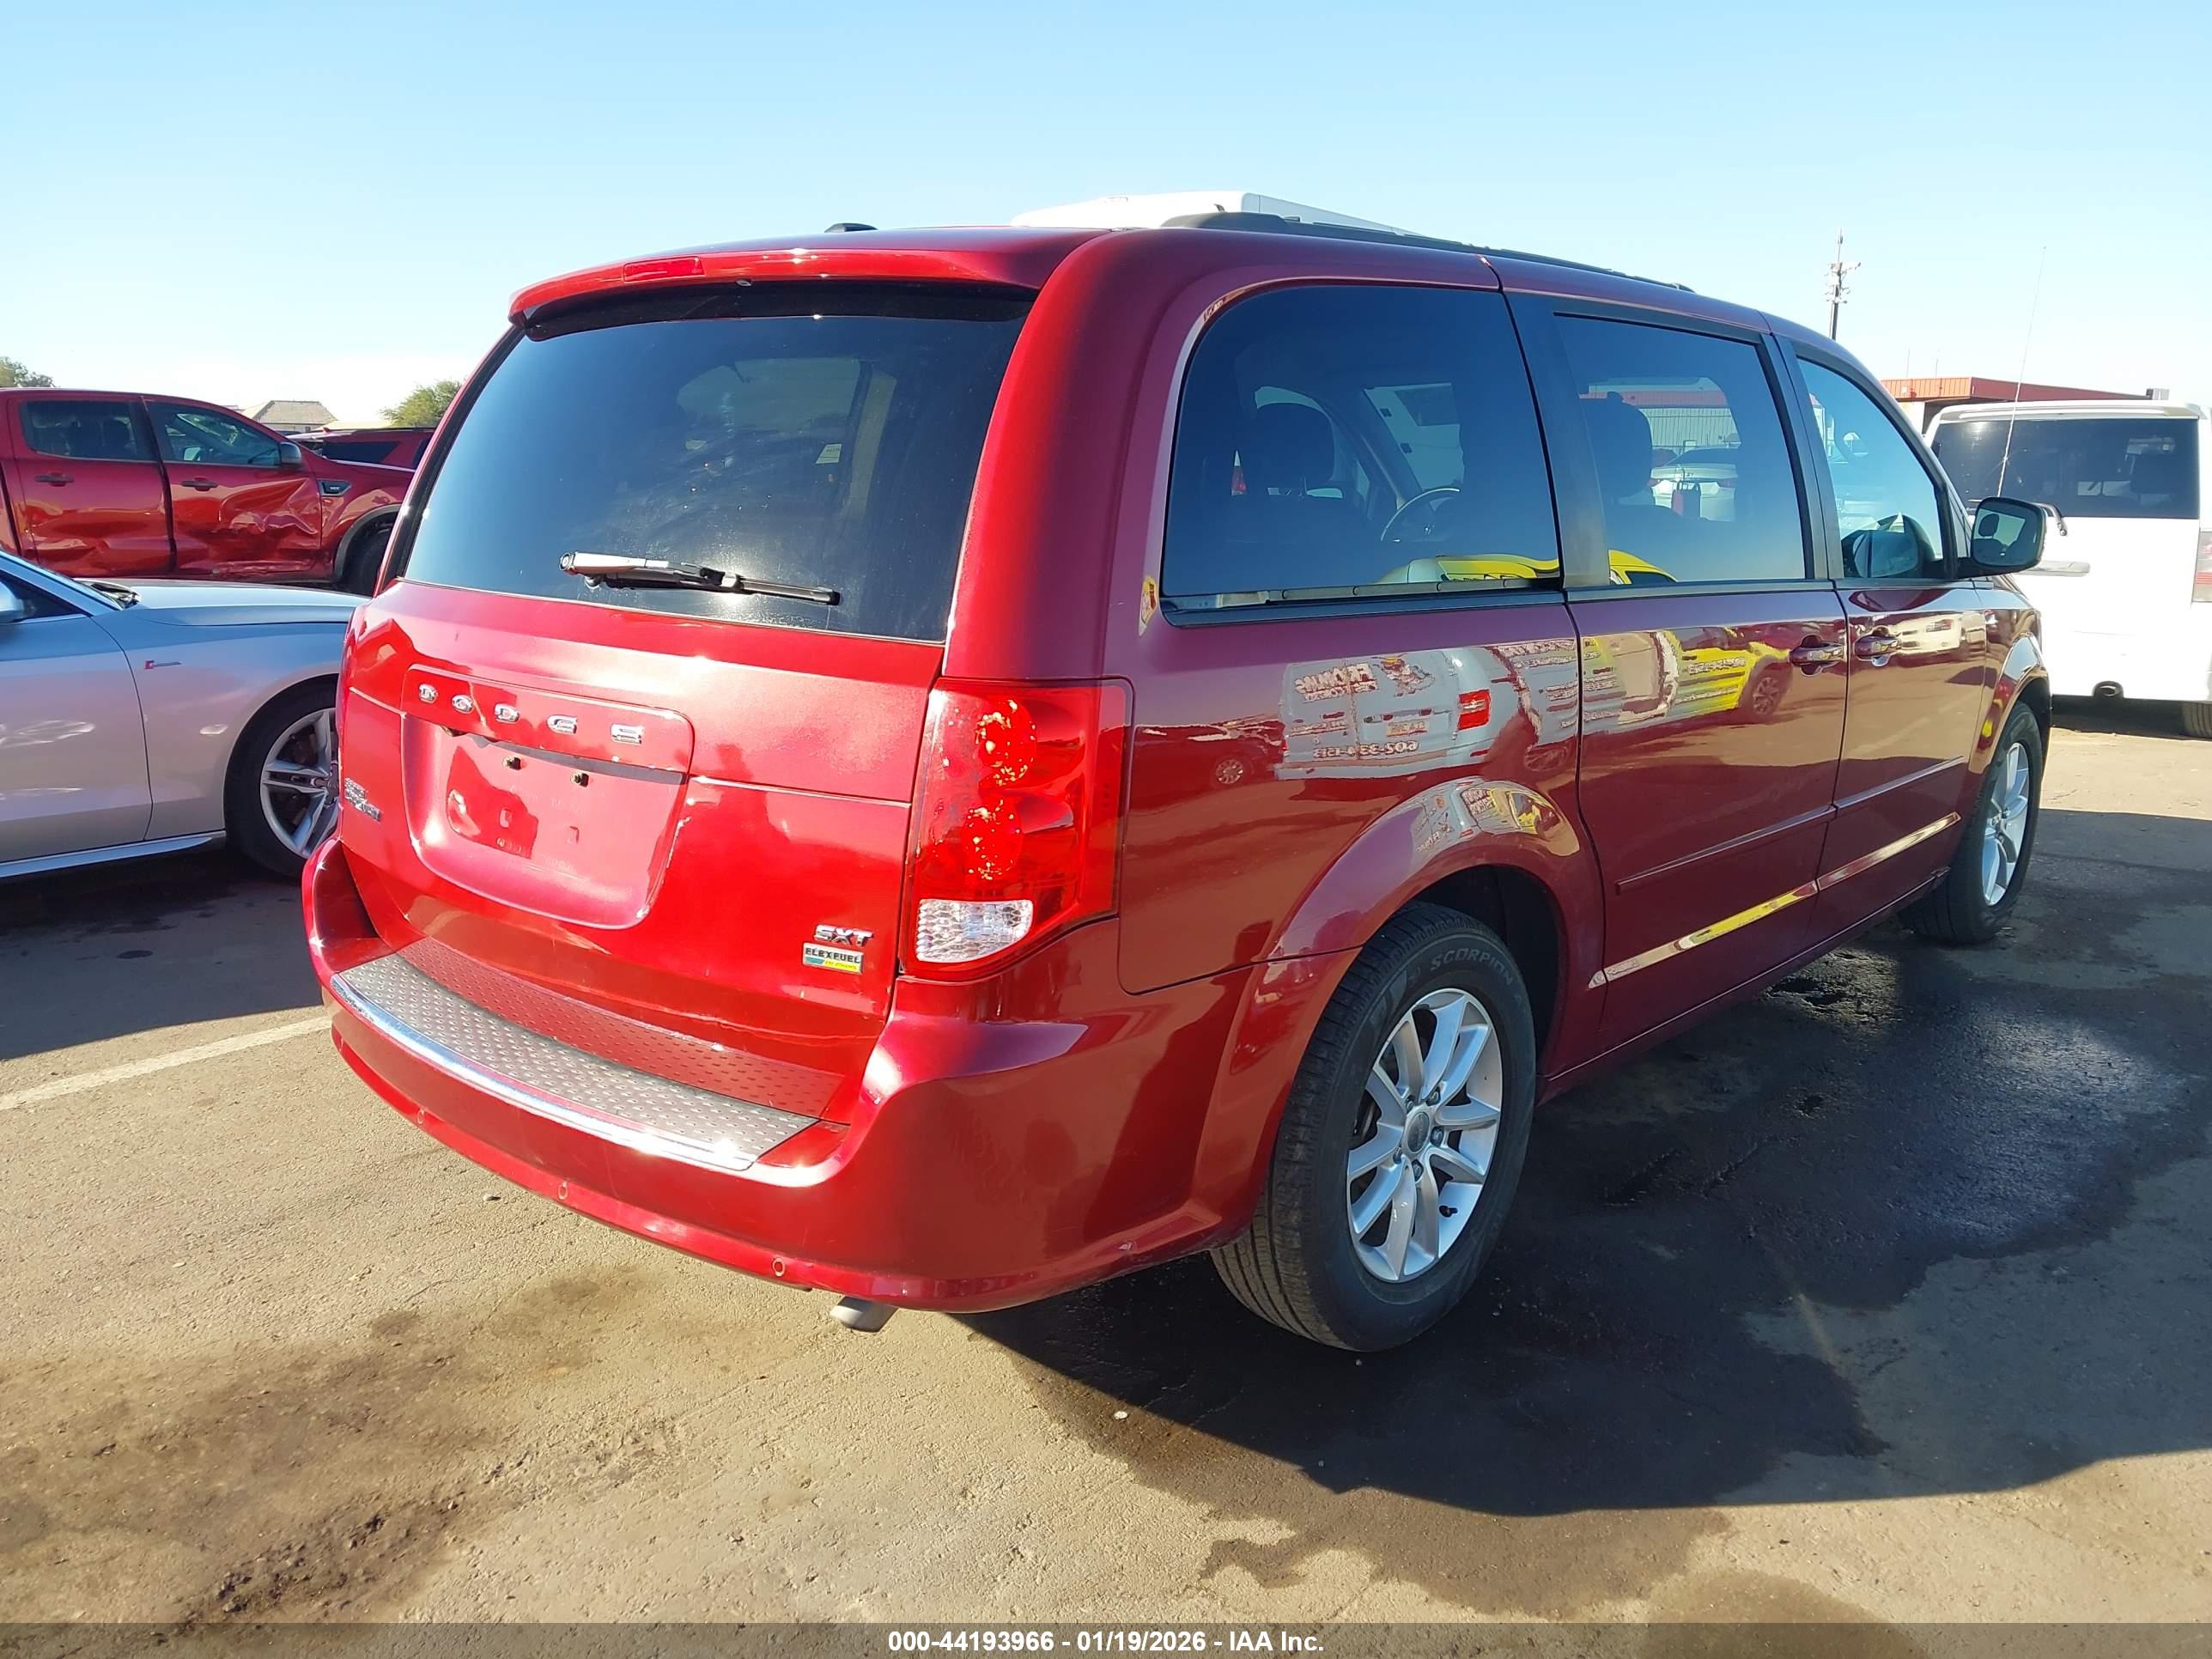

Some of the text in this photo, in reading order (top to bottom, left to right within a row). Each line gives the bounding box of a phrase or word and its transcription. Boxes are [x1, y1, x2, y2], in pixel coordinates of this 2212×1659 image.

[418, 683, 644, 745] DODGE
[813, 924, 874, 947] SXT
[1430, 946, 1514, 986] SCORPION
